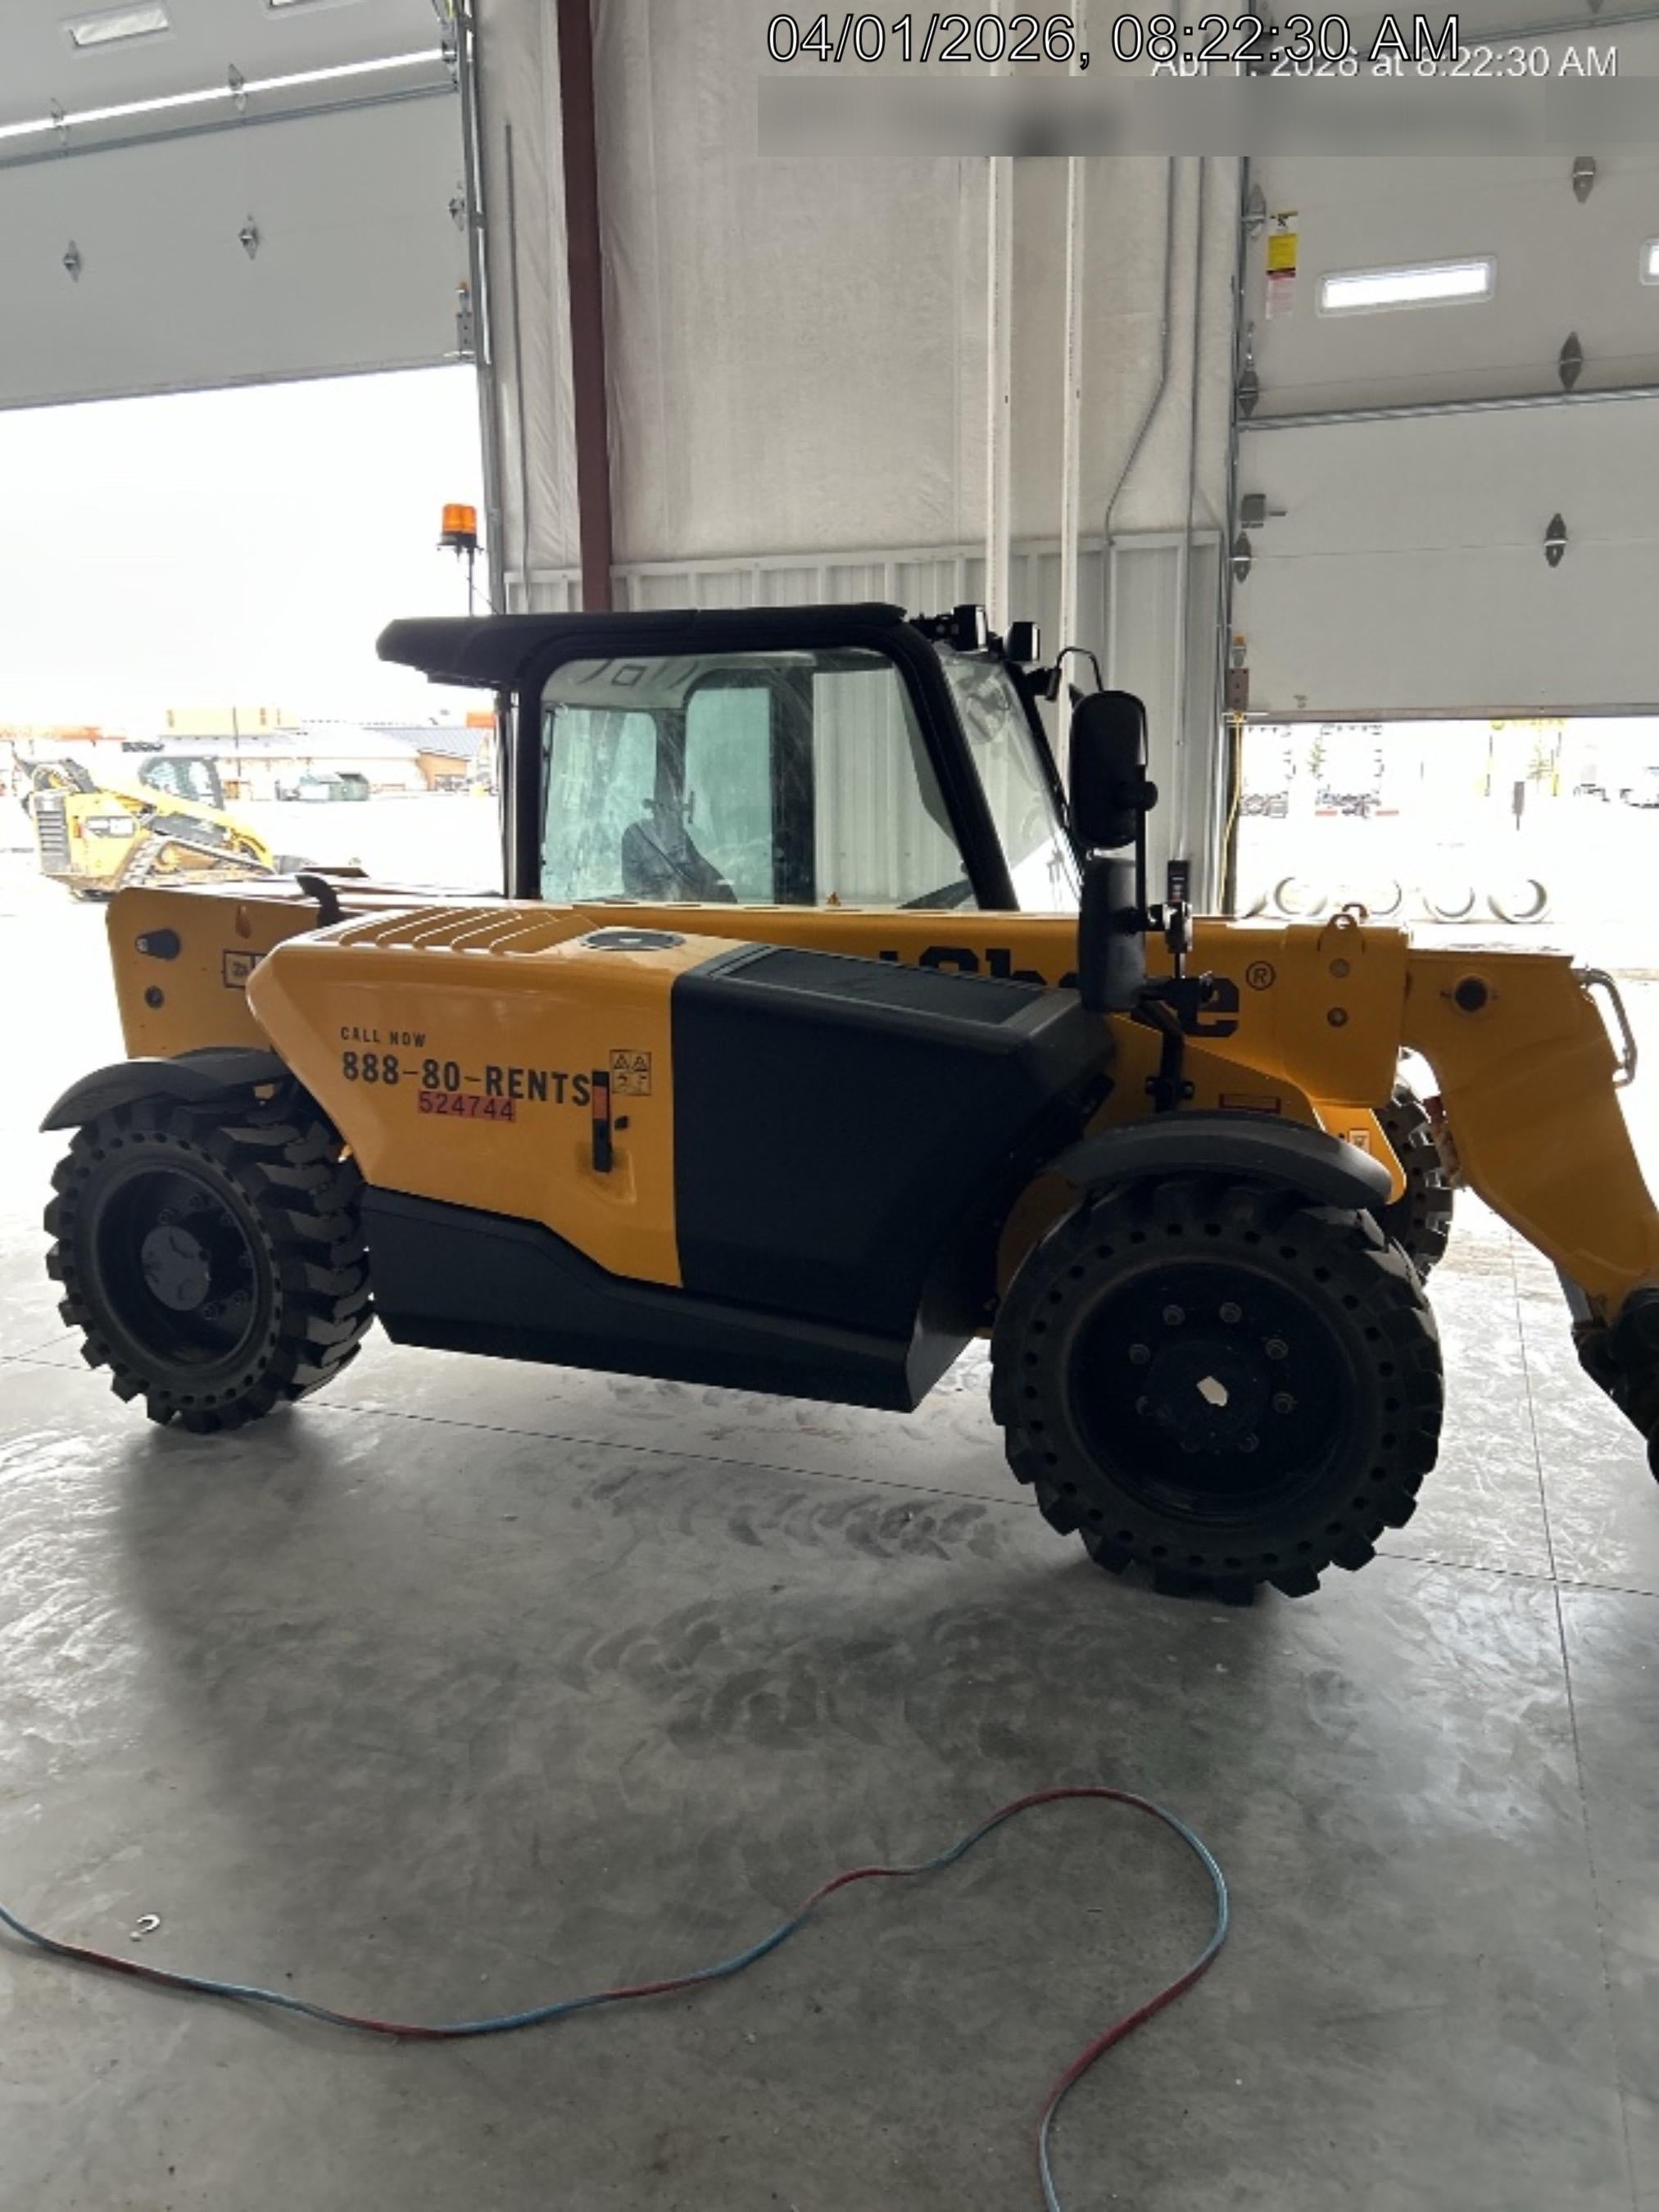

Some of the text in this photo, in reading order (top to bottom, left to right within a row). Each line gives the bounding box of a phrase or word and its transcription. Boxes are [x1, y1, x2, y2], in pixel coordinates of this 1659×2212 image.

[341, 1027, 425, 1048] CALL NOW
[342, 1051, 591, 1107] 888-80-RENTS
[419, 1090, 514, 1121] 524744
